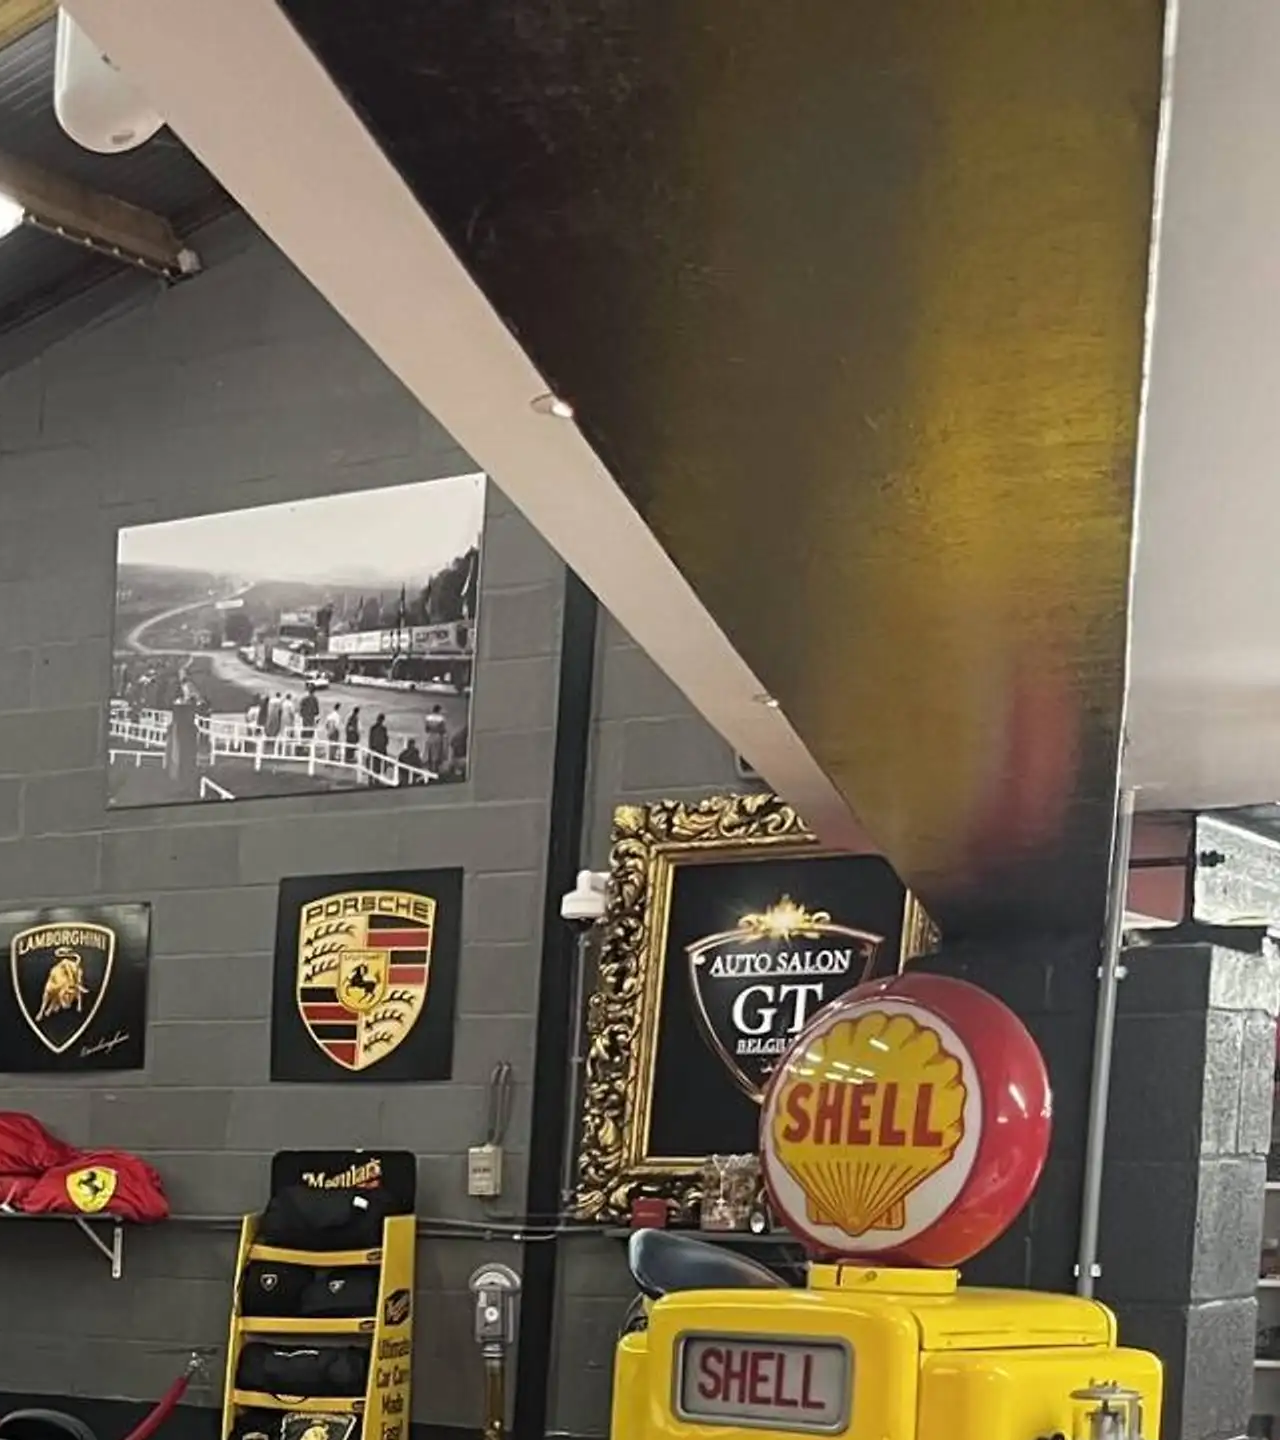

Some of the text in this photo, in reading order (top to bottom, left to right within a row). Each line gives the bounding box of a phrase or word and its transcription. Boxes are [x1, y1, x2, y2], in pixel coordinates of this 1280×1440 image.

[305, 895, 429, 925] PORSCHE
[18, 929, 108, 956] LAMBORGHINI
[709, 949, 852, 976] AUTO SALON
[731, 982, 824, 1036] GT
[782, 1081, 944, 1148] SHELL
[697, 1346, 826, 1410] SHELL
